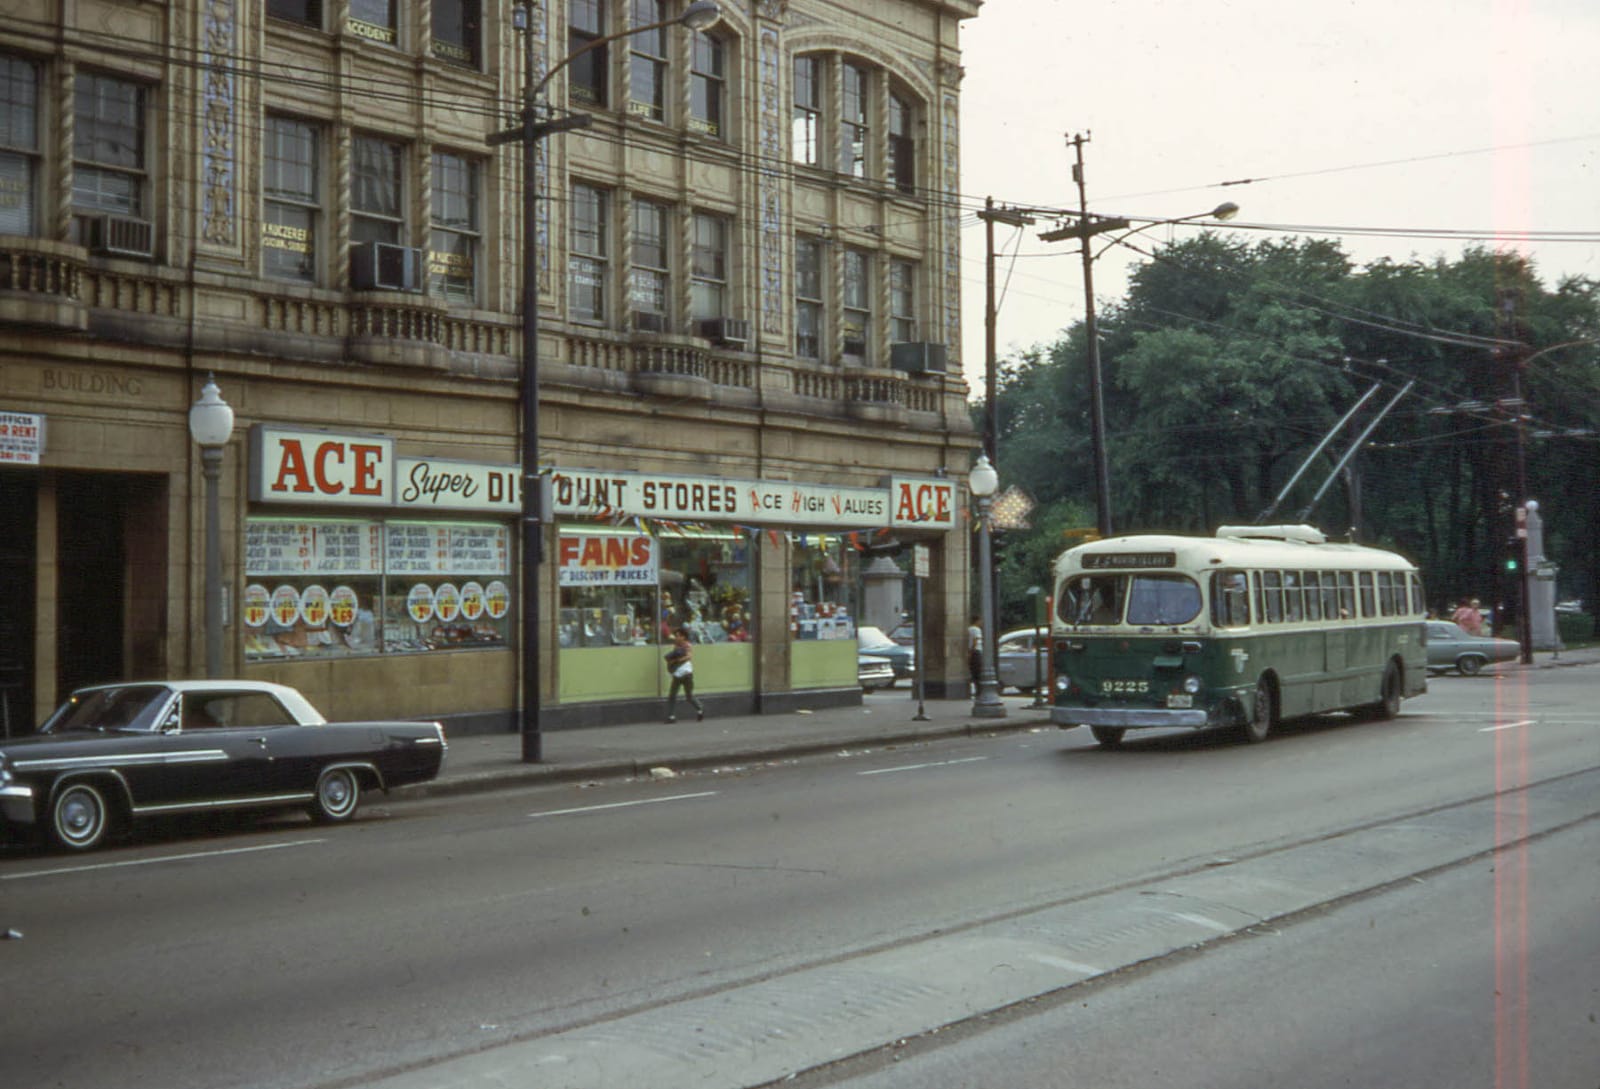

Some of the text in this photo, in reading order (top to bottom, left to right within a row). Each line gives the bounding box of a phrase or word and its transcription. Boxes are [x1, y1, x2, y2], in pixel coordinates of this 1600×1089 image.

[43, 370, 142, 396] BUILDING
[0, 414, 32, 425] FFICES
[12, 426, 37, 438] RENT
[271, 438, 382, 496] ACE
[403, 462, 478, 503] Super
[488, 471, 627, 508] DIOUNT
[643, 481, 737, 513] STORES
[831, 494, 883, 515] VALUES
[896, 483, 951, 522] ACE
[560, 537, 651, 567] FANS
[570, 569, 609, 582] DISCOUNT
[1102, 681, 1150, 693] 9225
